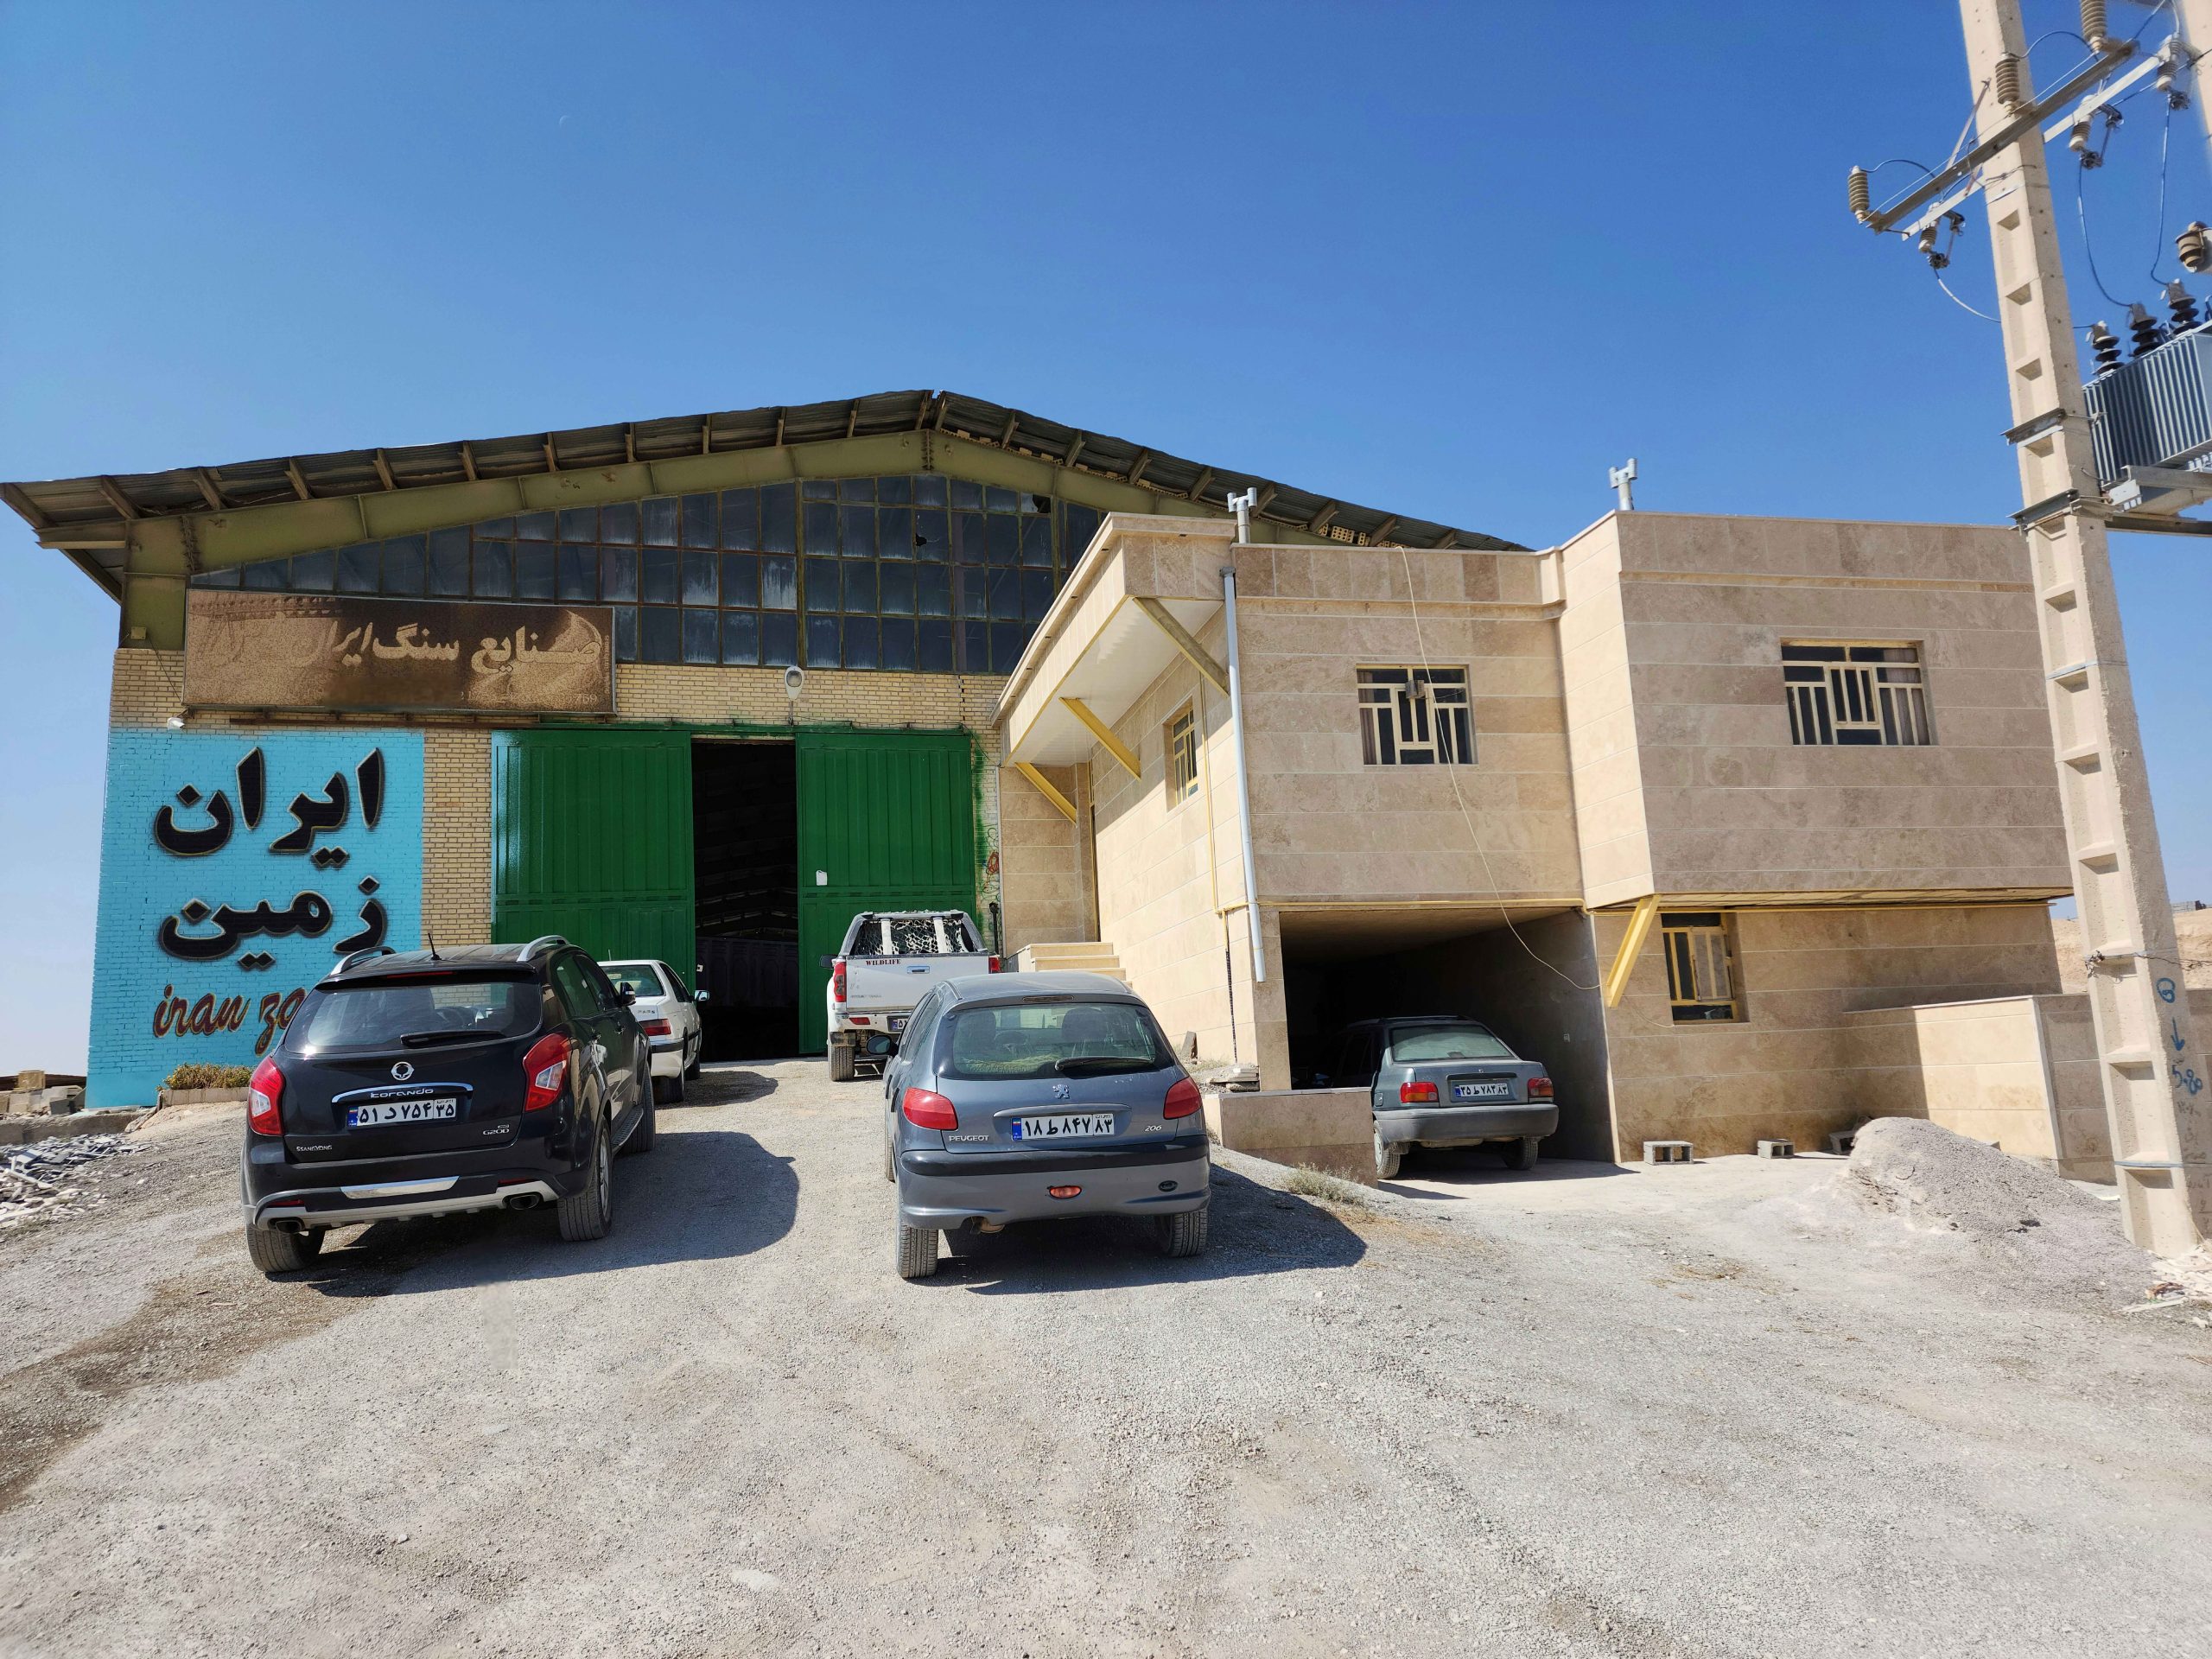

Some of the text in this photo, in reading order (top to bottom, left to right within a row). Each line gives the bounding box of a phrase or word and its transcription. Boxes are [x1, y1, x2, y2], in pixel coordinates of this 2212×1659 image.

[372, 622, 460, 660] سنگ
[471, 625, 601, 675] صنایع
[155, 747, 385, 868] ایران
[159, 874, 387, 970] زمین
[153, 983, 251, 1038] iran
